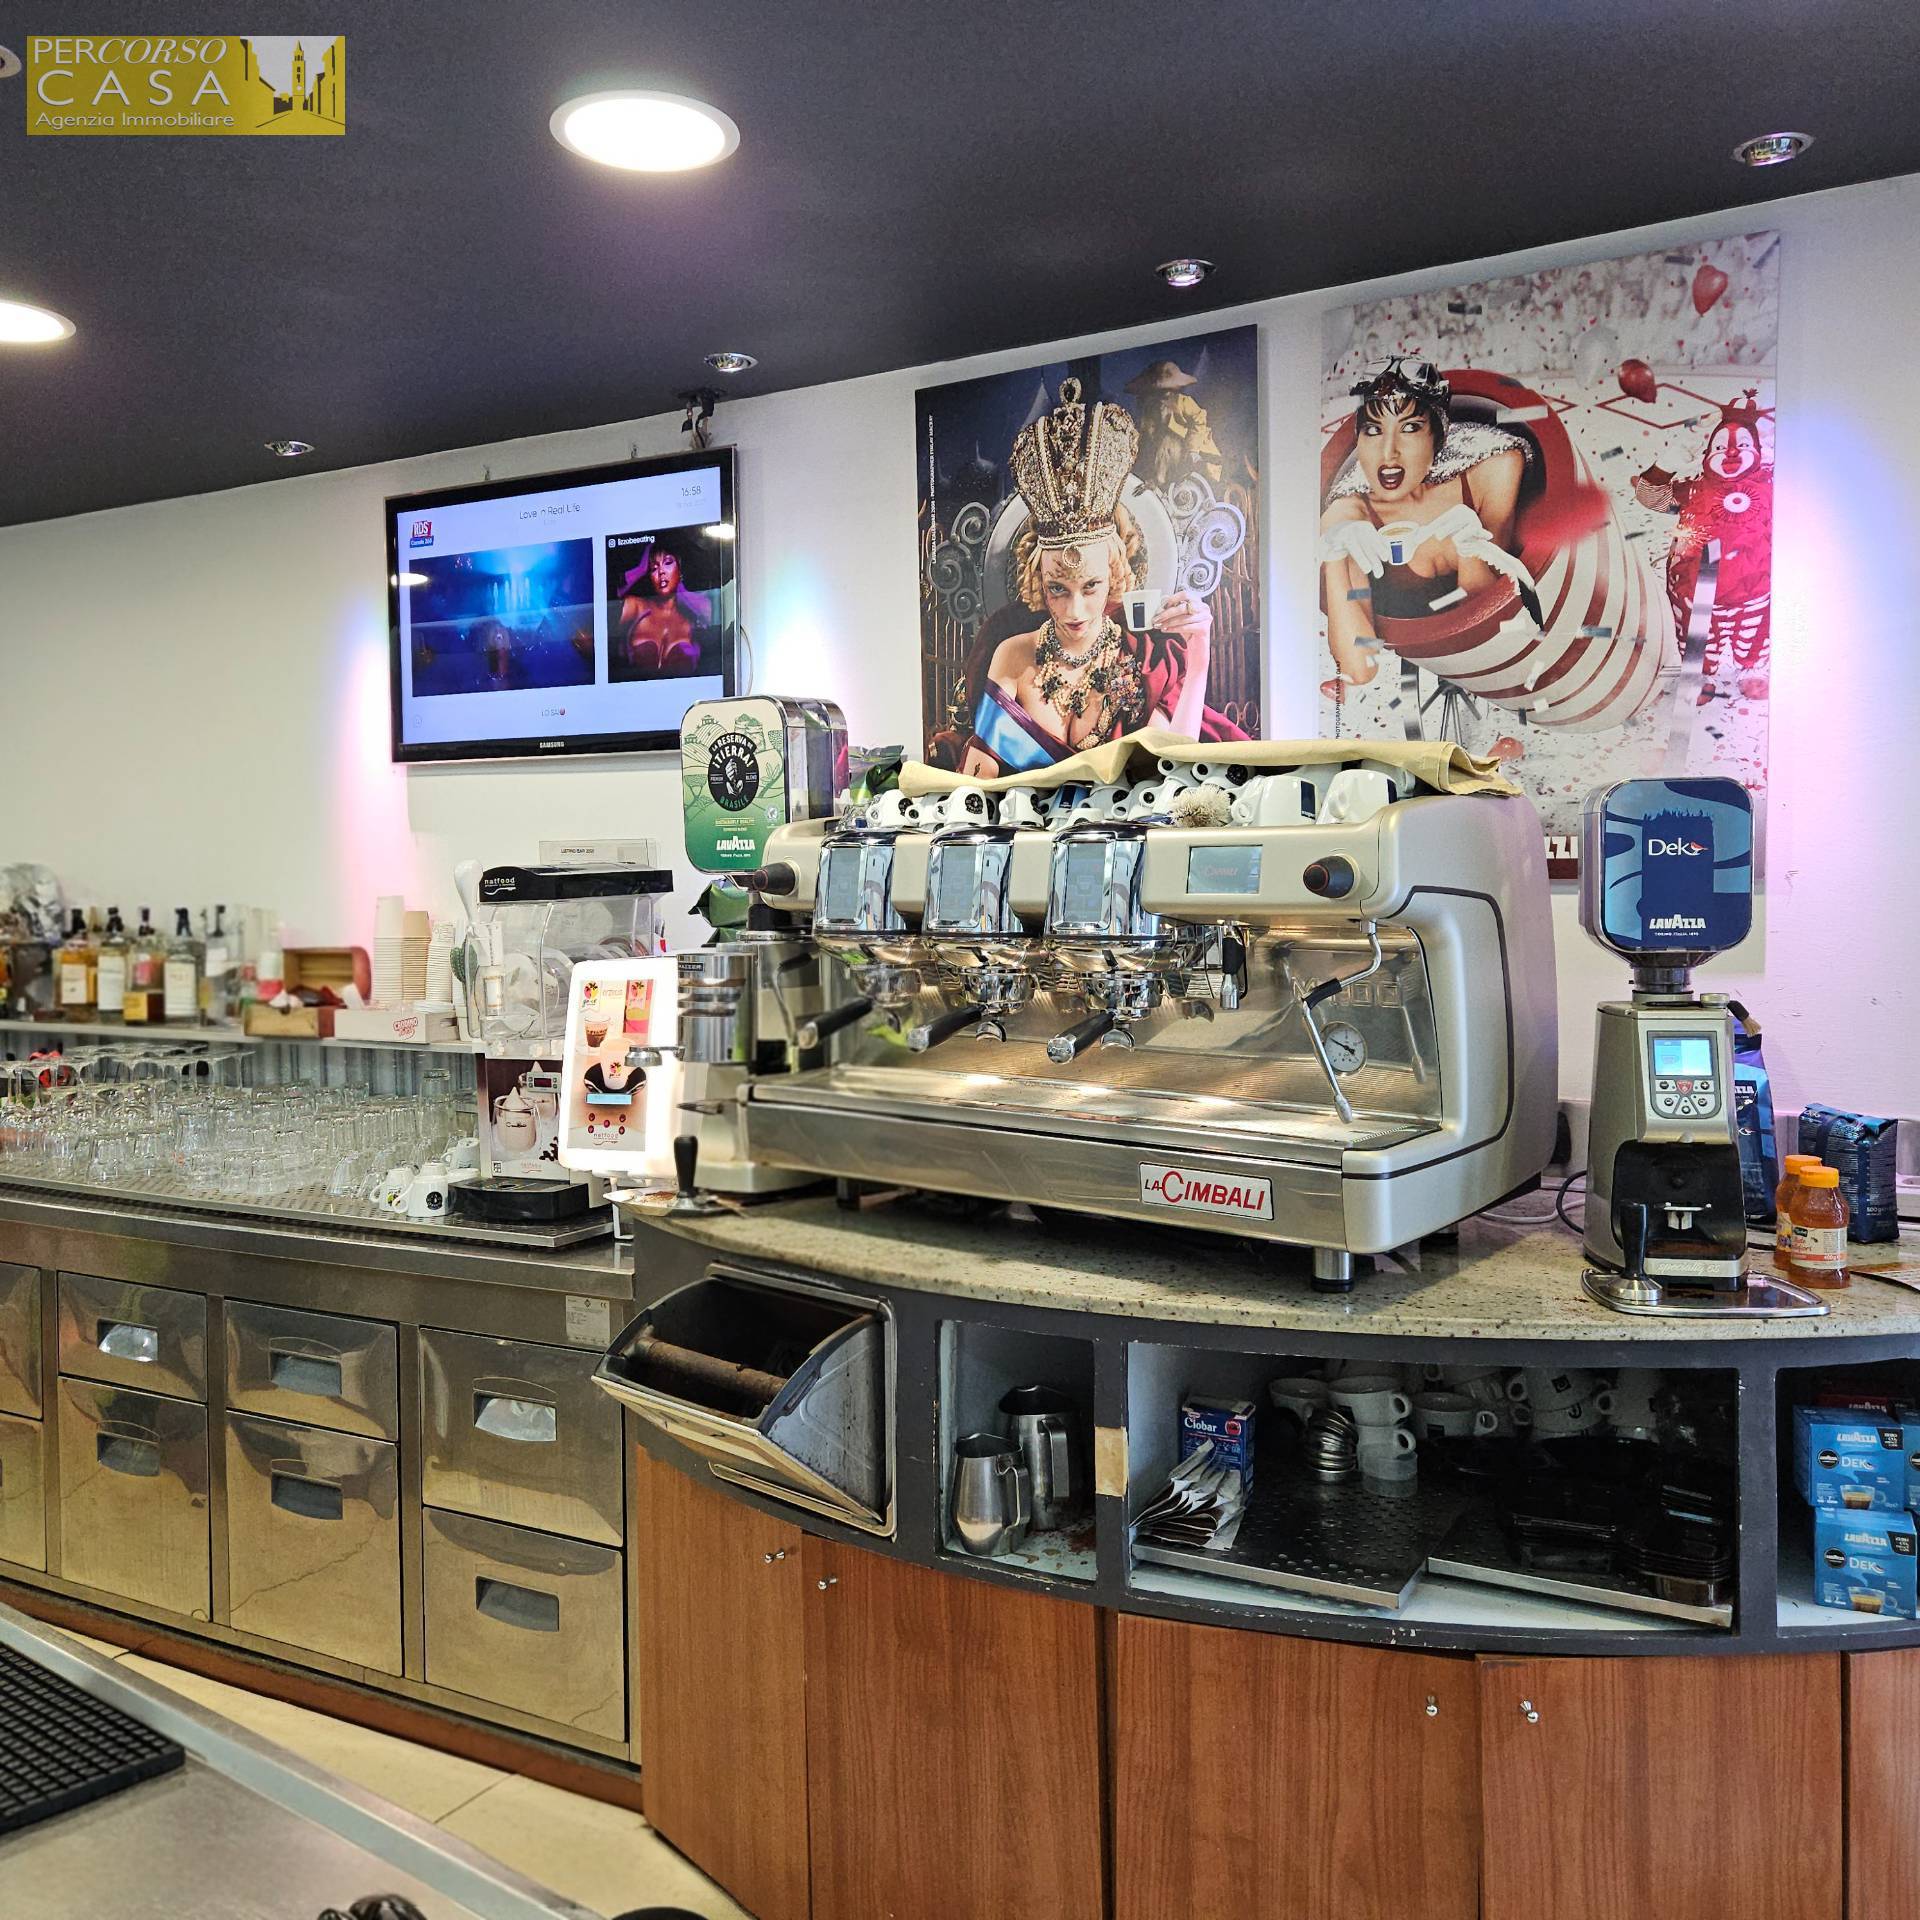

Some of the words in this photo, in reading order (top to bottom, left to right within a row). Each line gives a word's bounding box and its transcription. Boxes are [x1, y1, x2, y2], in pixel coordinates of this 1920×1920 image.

[681, 485, 702, 497] 16:58
[519, 509, 538, 520] Love
[547, 505, 565, 516] Real
[566, 502, 581, 513] Lfe
[413, 521, 429, 535] RDS
[539, 741, 565, 749] SAMSUNG
[717, 734, 747, 748] RESERVA
[716, 835, 756, 851] LAVAZZA
[1648, 837, 1696, 856] Dek
[484, 877, 516, 886] natfood
[1649, 913, 1707, 930] LAVAZZA
[1144, 1178, 1160, 1192] LA
[1161, 1170, 1266, 1211] CIMBALI
[1656, 1261, 1706, 1275] specialty
[1836, 1431, 1878, 1444] LAVAZZA
[1844, 1532, 1889, 1547] LAVAZZA
